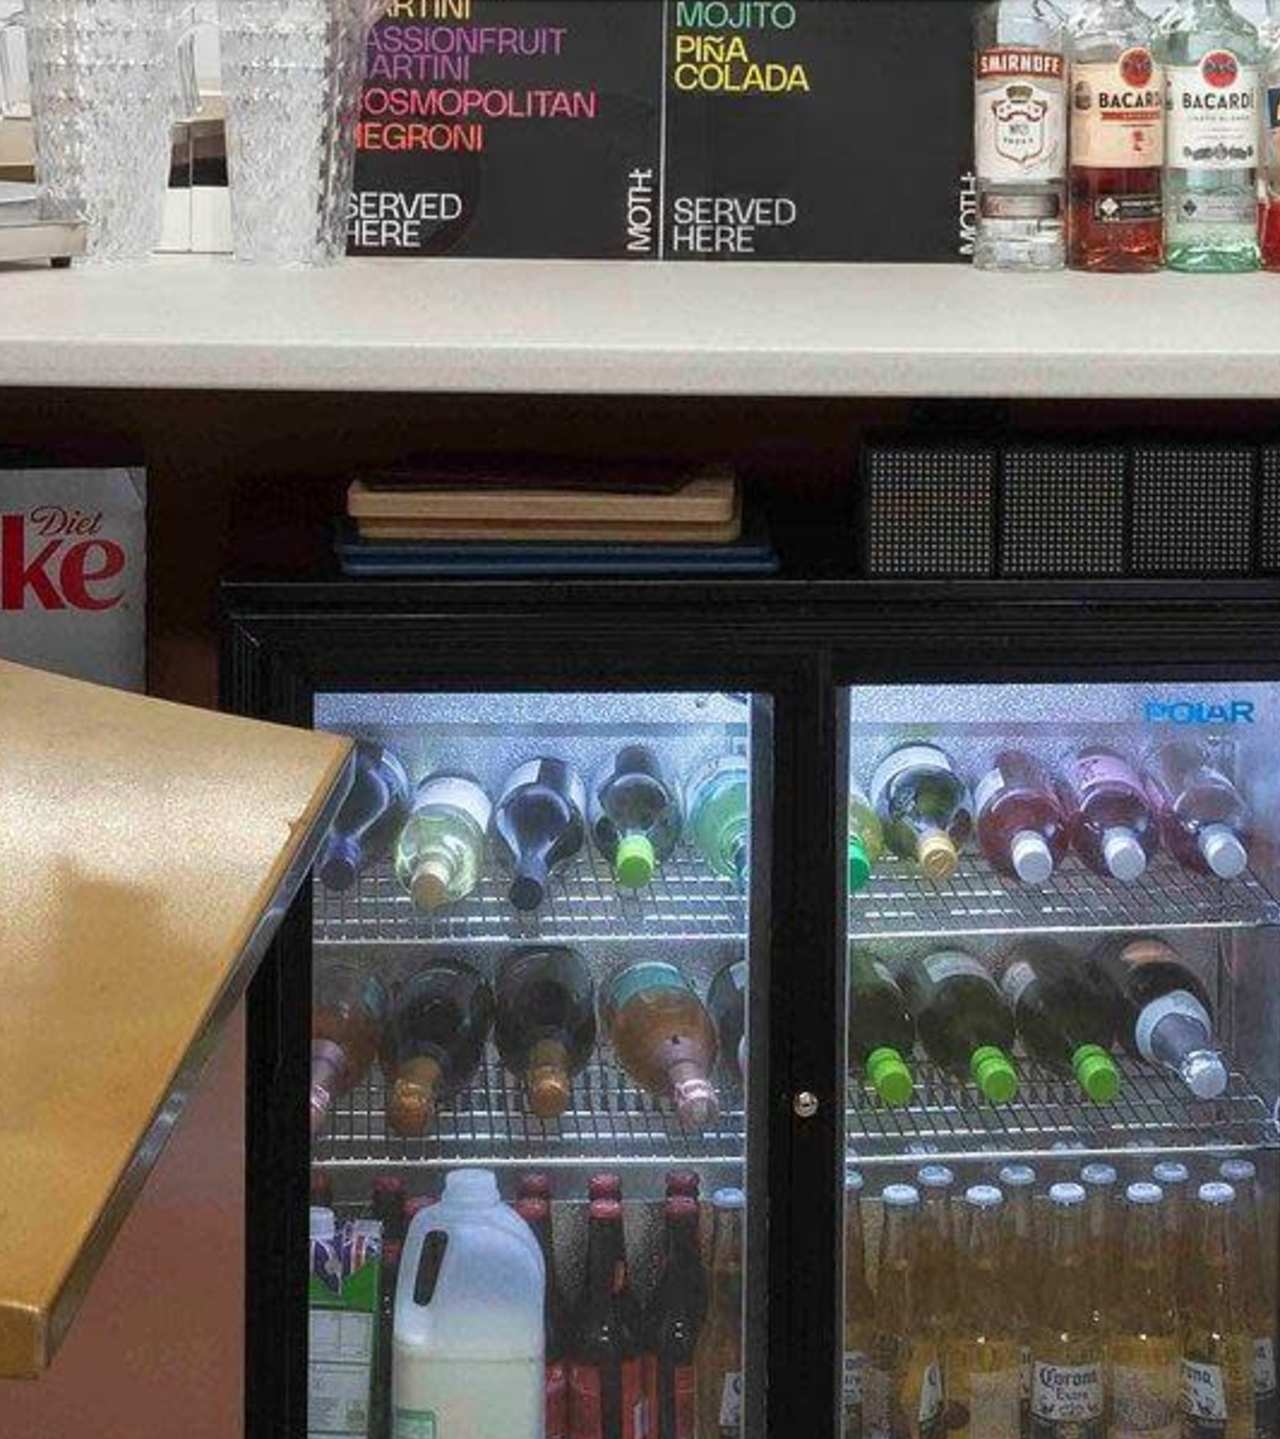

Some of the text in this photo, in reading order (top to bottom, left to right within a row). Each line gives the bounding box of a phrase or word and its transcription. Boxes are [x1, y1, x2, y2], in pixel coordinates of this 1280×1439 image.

[676, 1, 797, 29] MOJITO
[364, 24, 567, 56] ASSIONFRUIT
[676, 34, 748, 63] PIÑA
[675, 64, 810, 92] COLADA
[981, 54, 1061, 74] SMIRNOFF
[357, 87, 597, 119] OSMOPOLITAN
[627, 168, 651, 252] MOTH:
[673, 198, 797, 225] SERVED
[673, 226, 755, 253] HERE
[30, 505, 104, 537] Diet
